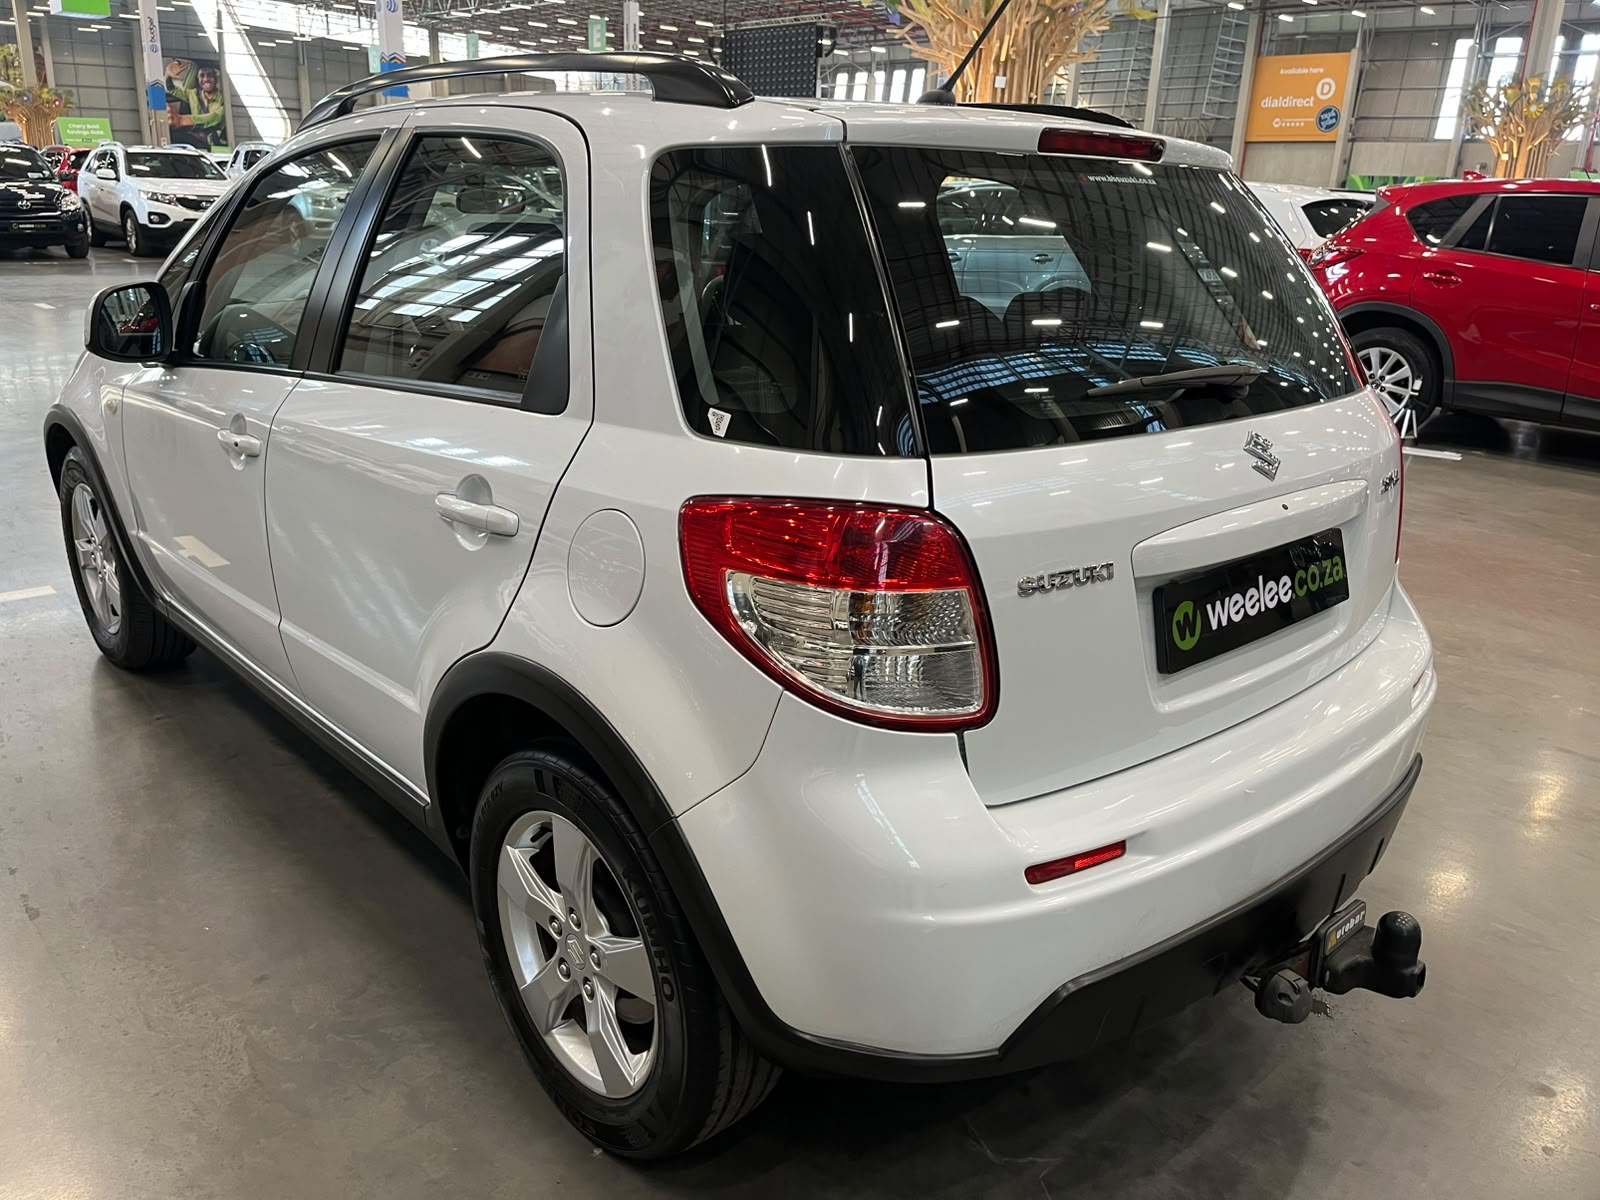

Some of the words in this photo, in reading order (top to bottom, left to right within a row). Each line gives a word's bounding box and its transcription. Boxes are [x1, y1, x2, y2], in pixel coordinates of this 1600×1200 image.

[1261, 96, 1315, 108] dialdirect
[1017, 561, 1115, 598] SUZUKI
[1336, 910, 1366, 940] probar
